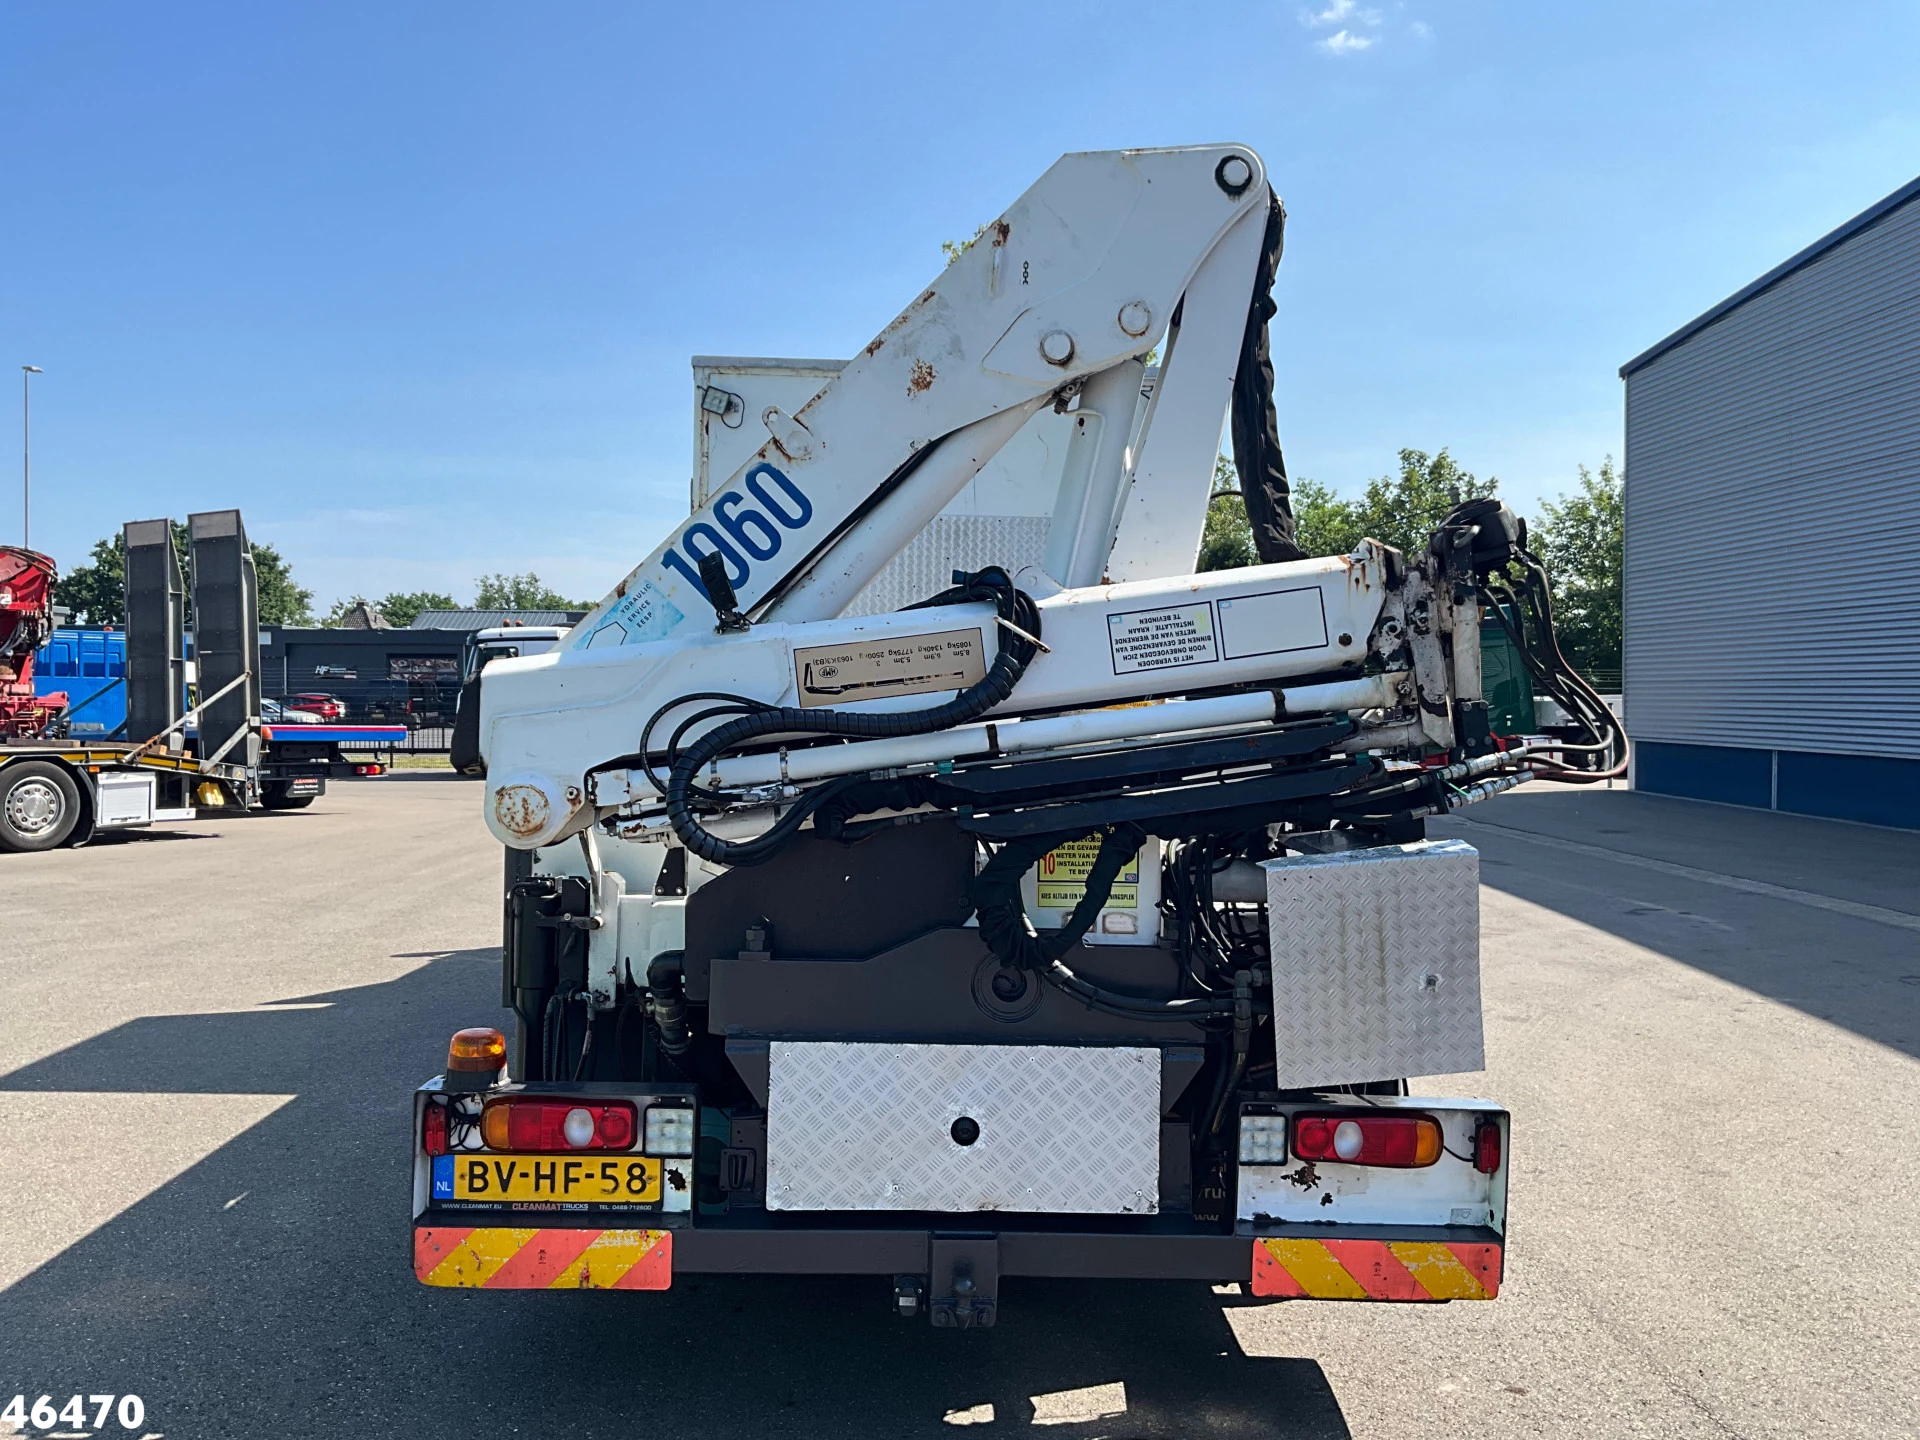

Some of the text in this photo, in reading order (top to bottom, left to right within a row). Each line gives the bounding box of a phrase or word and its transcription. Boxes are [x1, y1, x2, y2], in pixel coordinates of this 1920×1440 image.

[661, 463, 813, 610] 1060
[1139, 615, 1171, 625] BEVINDEN
[1128, 626, 1150, 634] KRAAN
[1155, 620, 1195, 631] INSTALLATIE
[1175, 628, 1197, 637] METER
[1114, 635, 1149, 645] WERKENDE
[1187, 635, 1212, 643] BINNEN
[1130, 640, 1176, 651] GEVARENZONE
[888, 648, 913, 656] 1775kg
[1122, 644, 1206, 661] VOOR ONBEVOEGDEN ZICH
[893, 656, 911, 664] 5,3m
[1137, 657, 1171, 668] VERBODEN
[1042, 853, 1056, 875] 10
[468, 1161, 647, 1195] BV-HF-58
[436, 1182, 452, 1192] NL
[512, 1203, 562, 1211] CLEANMAT
